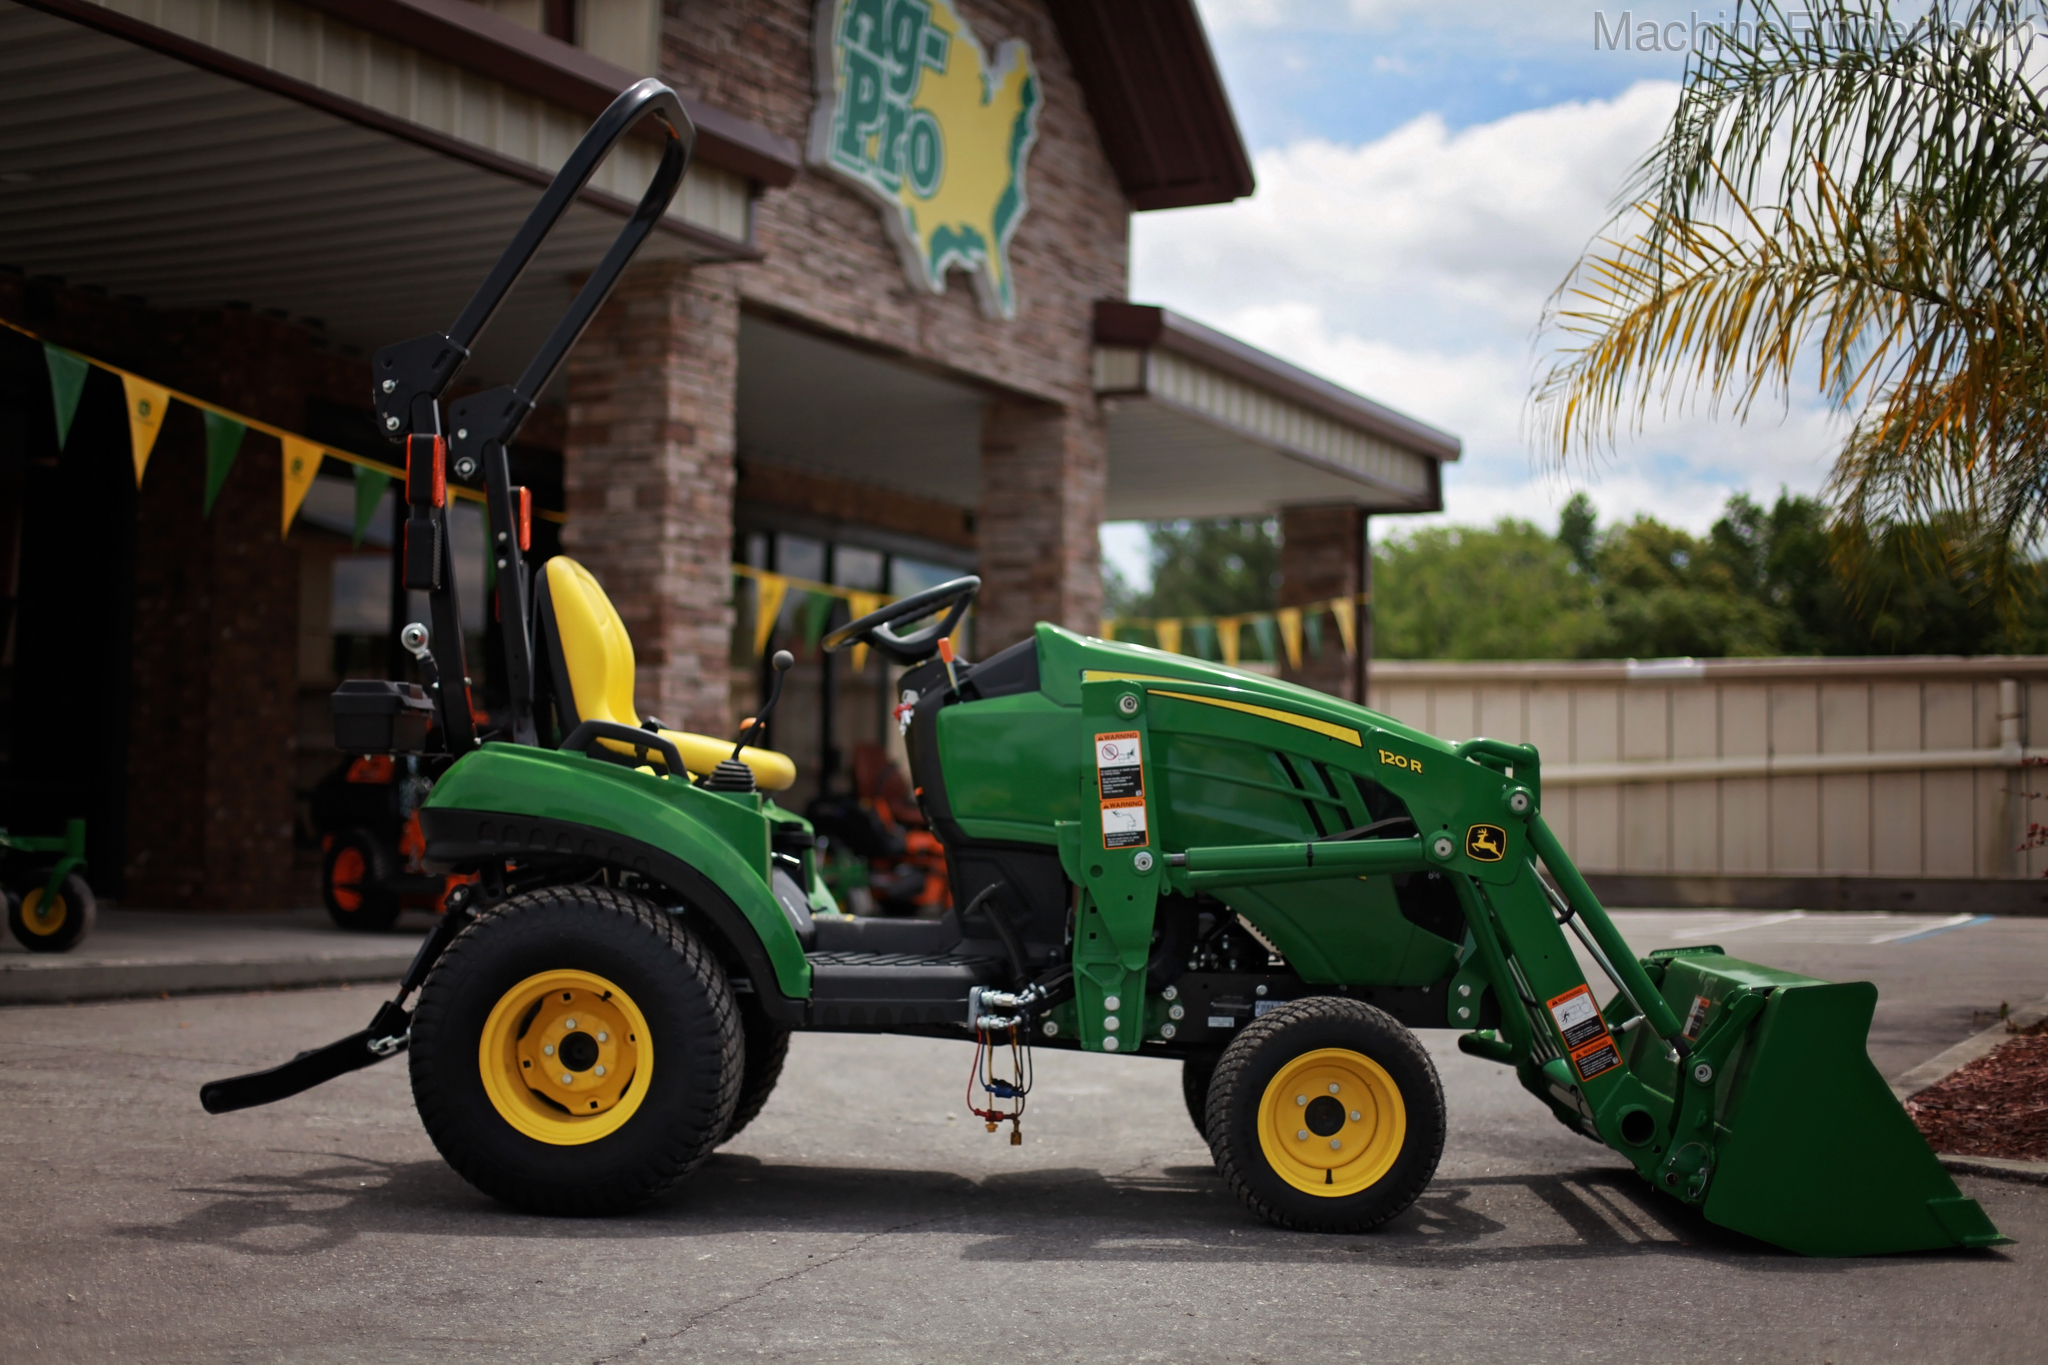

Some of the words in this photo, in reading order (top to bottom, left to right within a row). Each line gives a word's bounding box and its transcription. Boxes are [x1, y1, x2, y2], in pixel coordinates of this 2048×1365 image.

[840, 0, 948, 96] Ag-
[838, 48, 943, 195] Pro
[1104, 732, 1138, 741] WARNING
[1379, 749, 1408, 768] 120
[1410, 758, 1422, 773] R
[1110, 800, 1143, 809] WARNING
[1558, 988, 1584, 1003] WARNING
[1582, 1040, 1609, 1055] WARNING
